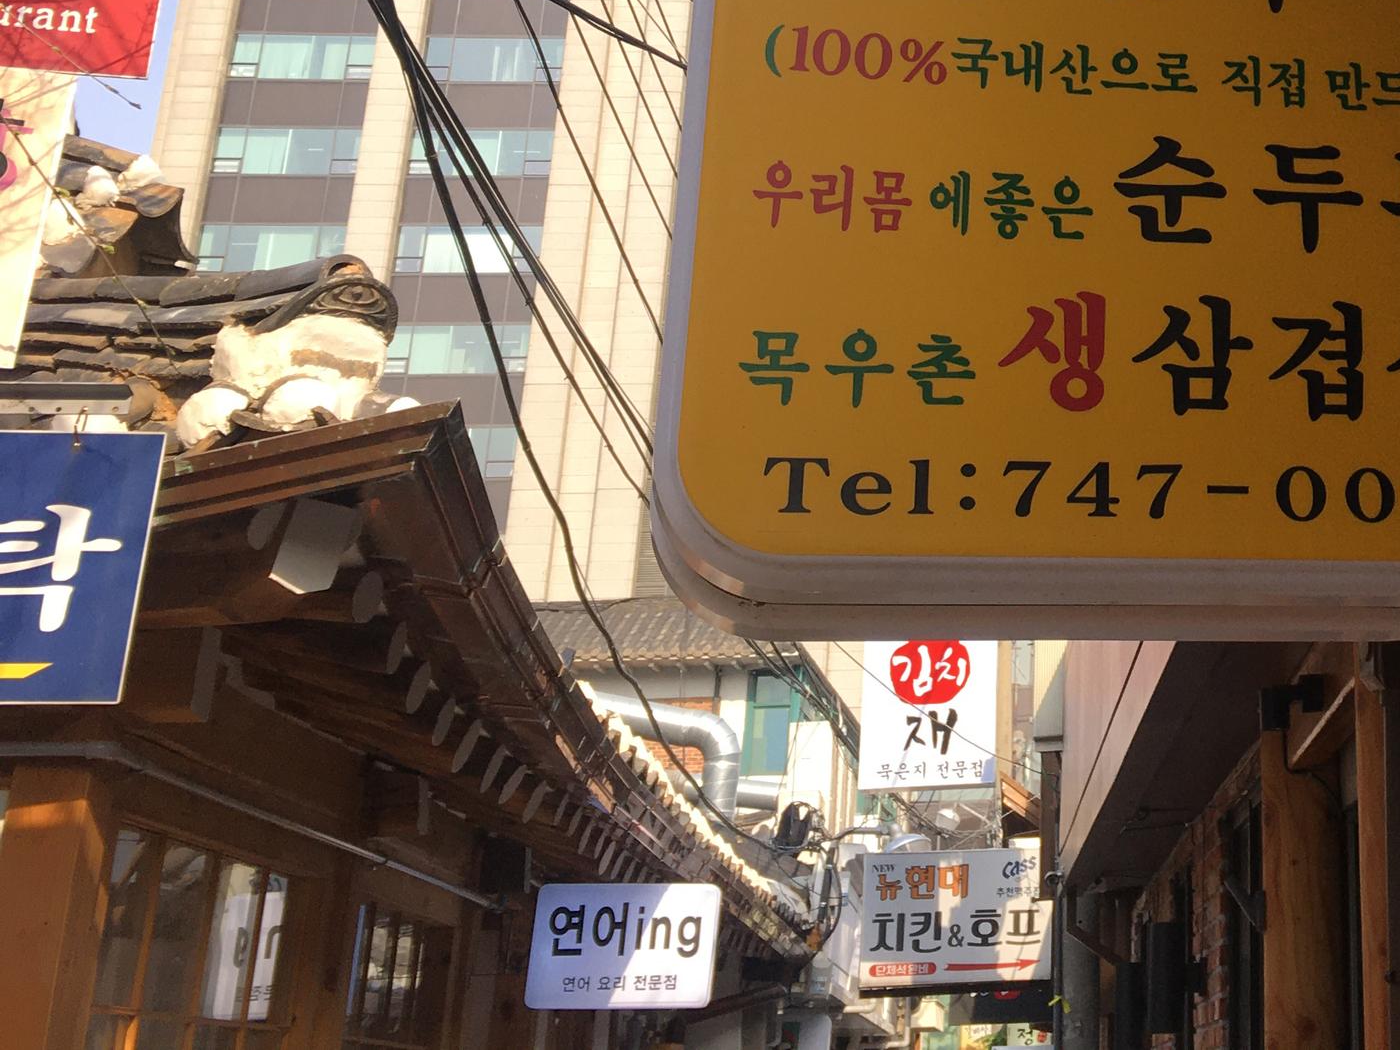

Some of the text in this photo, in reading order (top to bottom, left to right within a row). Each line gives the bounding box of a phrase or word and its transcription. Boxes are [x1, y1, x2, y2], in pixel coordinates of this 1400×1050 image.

[1222, 55, 1305, 108] 직접
[738, 328, 976, 409] 목우촌
[892, 645, 967, 697] 김치
[903, 708, 958, 755] 재
[877, 759, 984, 781] 묵은지 전문점
[875, 863, 970, 901] 뉴현대
[549, 902, 702, 958] 연어ing
[869, 909, 1041, 954] 치킨&호프
[562, 974, 678, 993] 연어 요리 전문점
